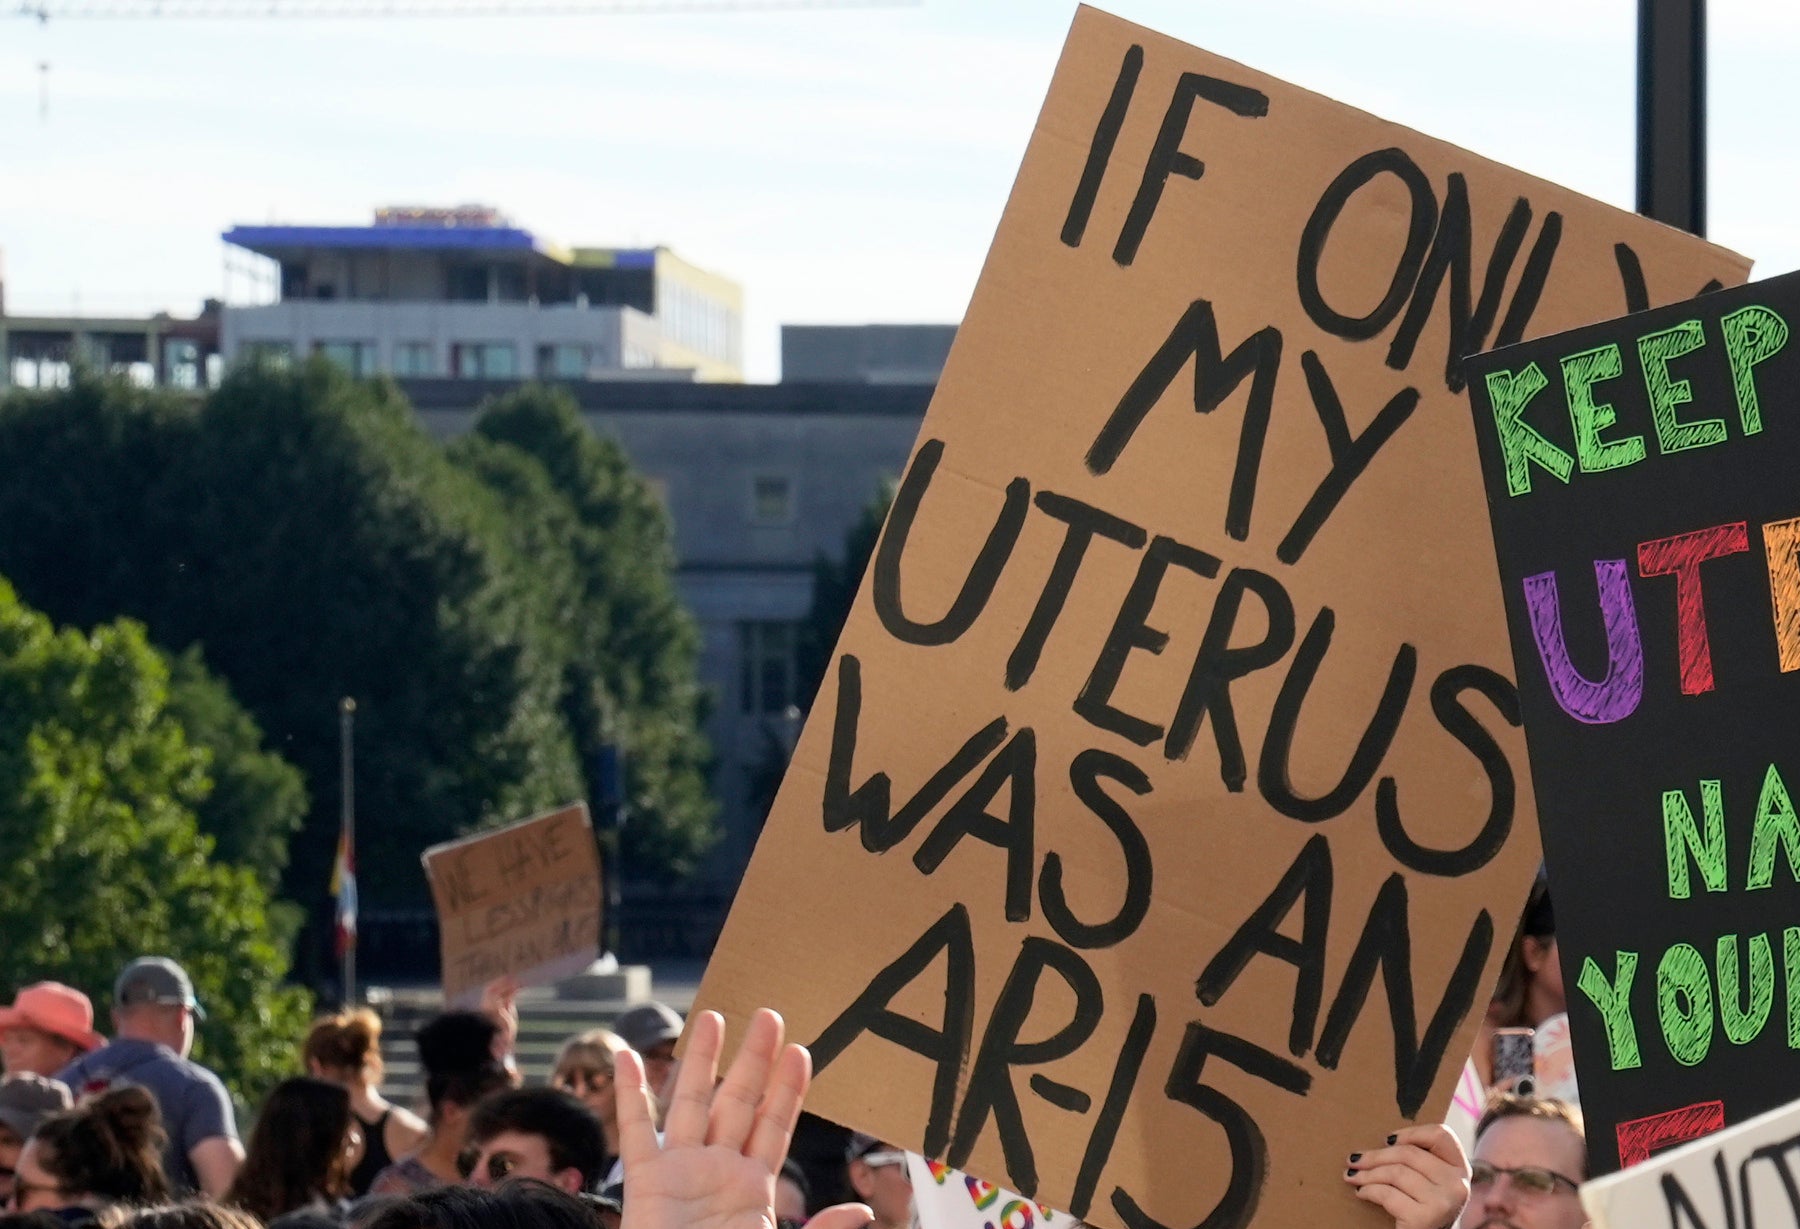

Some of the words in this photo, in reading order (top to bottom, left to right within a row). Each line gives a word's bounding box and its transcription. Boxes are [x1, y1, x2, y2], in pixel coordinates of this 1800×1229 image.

[1061, 44, 1269, 267] IF
[1086, 299, 1421, 565] MY
[1485, 305, 1790, 498] KEEP
[873, 439, 1522, 877] UTERUS
[823, 654, 1153, 949] WAS
[1196, 834, 1494, 1120] AN
